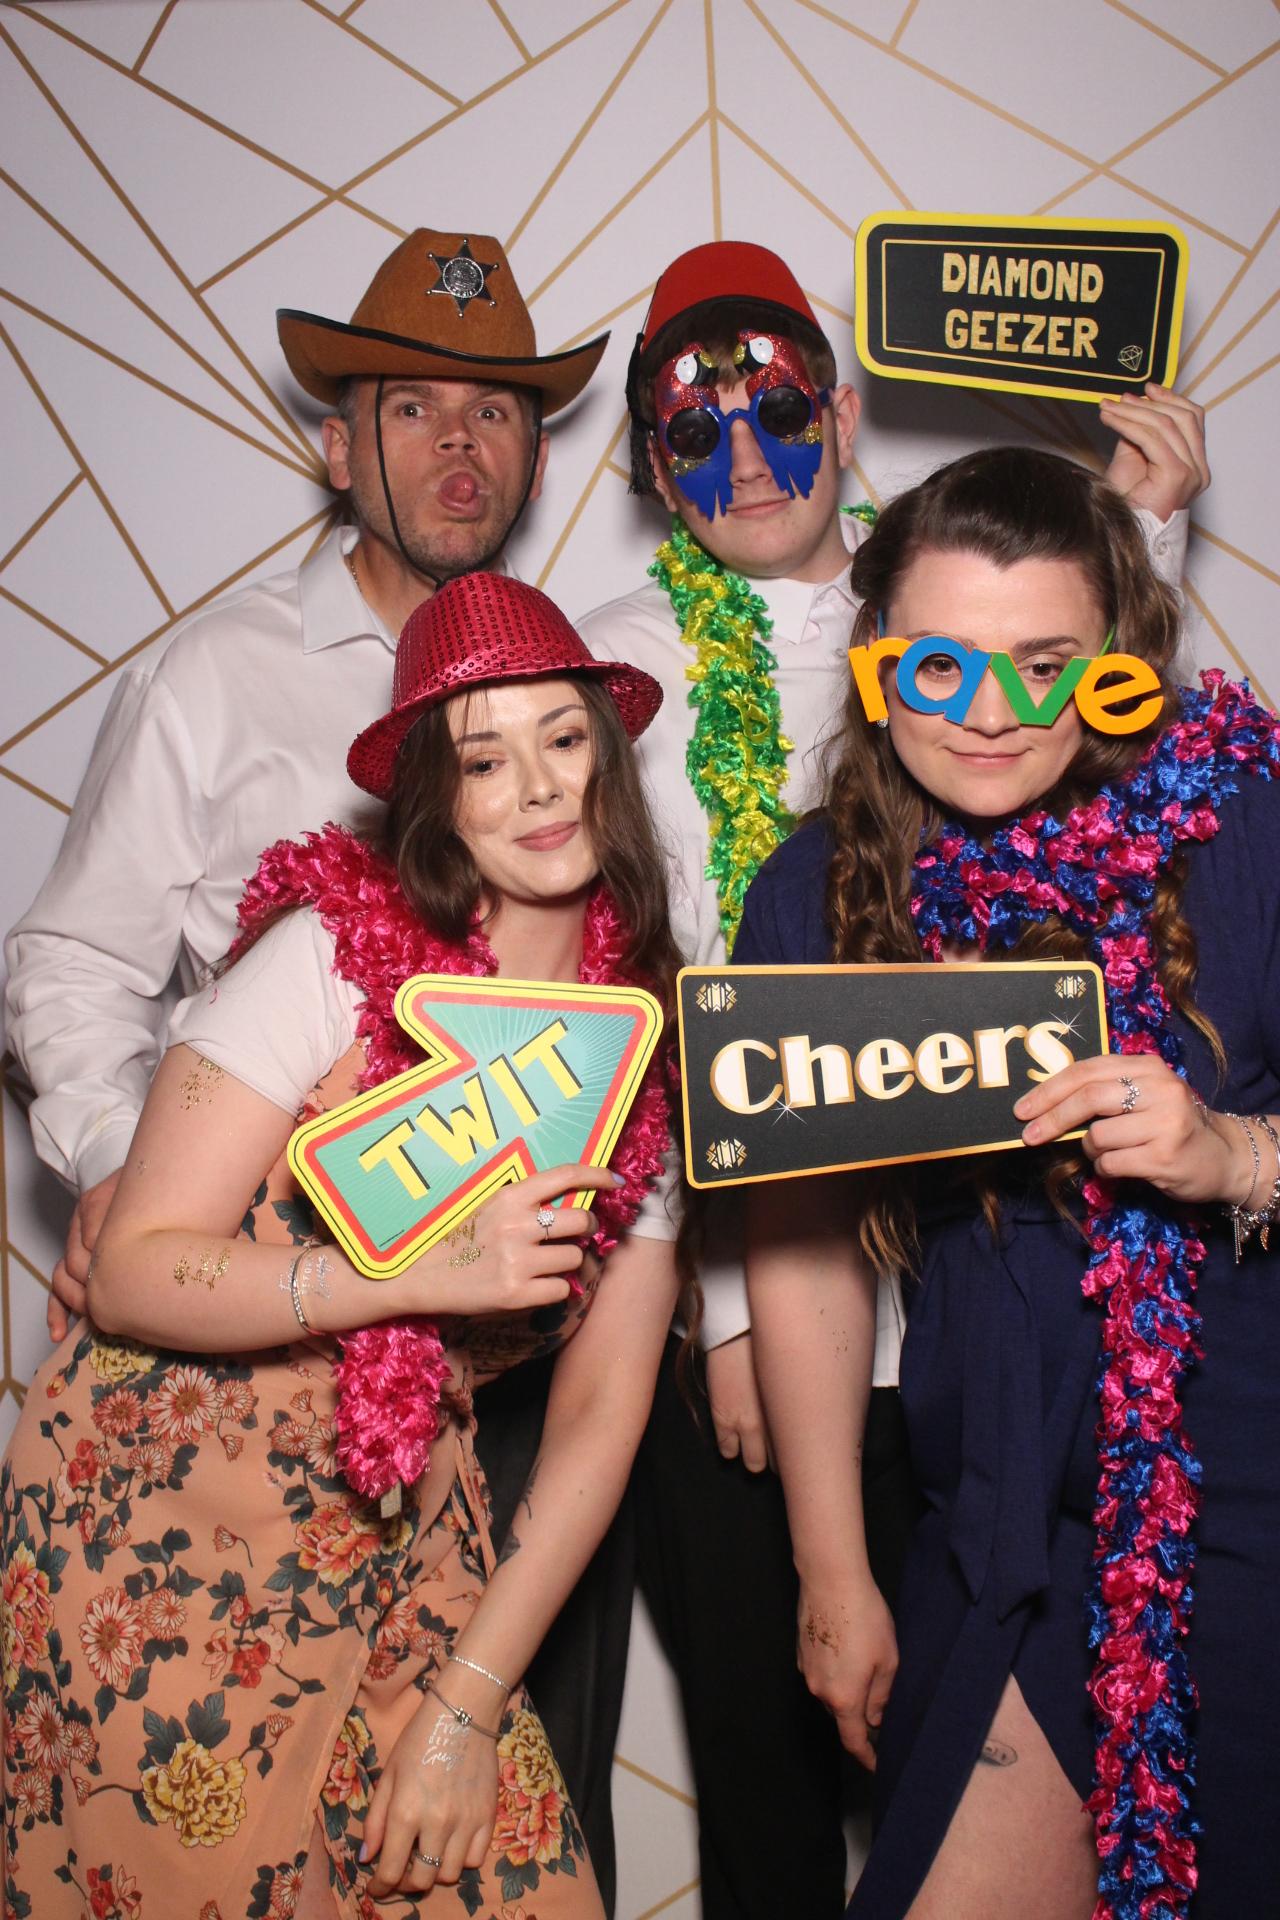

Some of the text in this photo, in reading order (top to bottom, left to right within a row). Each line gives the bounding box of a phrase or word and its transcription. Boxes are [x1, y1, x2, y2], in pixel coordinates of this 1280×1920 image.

[941, 252, 1104, 303] DIAMOND
[944, 308, 1099, 359] GEEZER
[848, 635, 1164, 735] rave
[358, 1017, 583, 1200] TWIT
[709, 1021, 1076, 1115] Cheers
